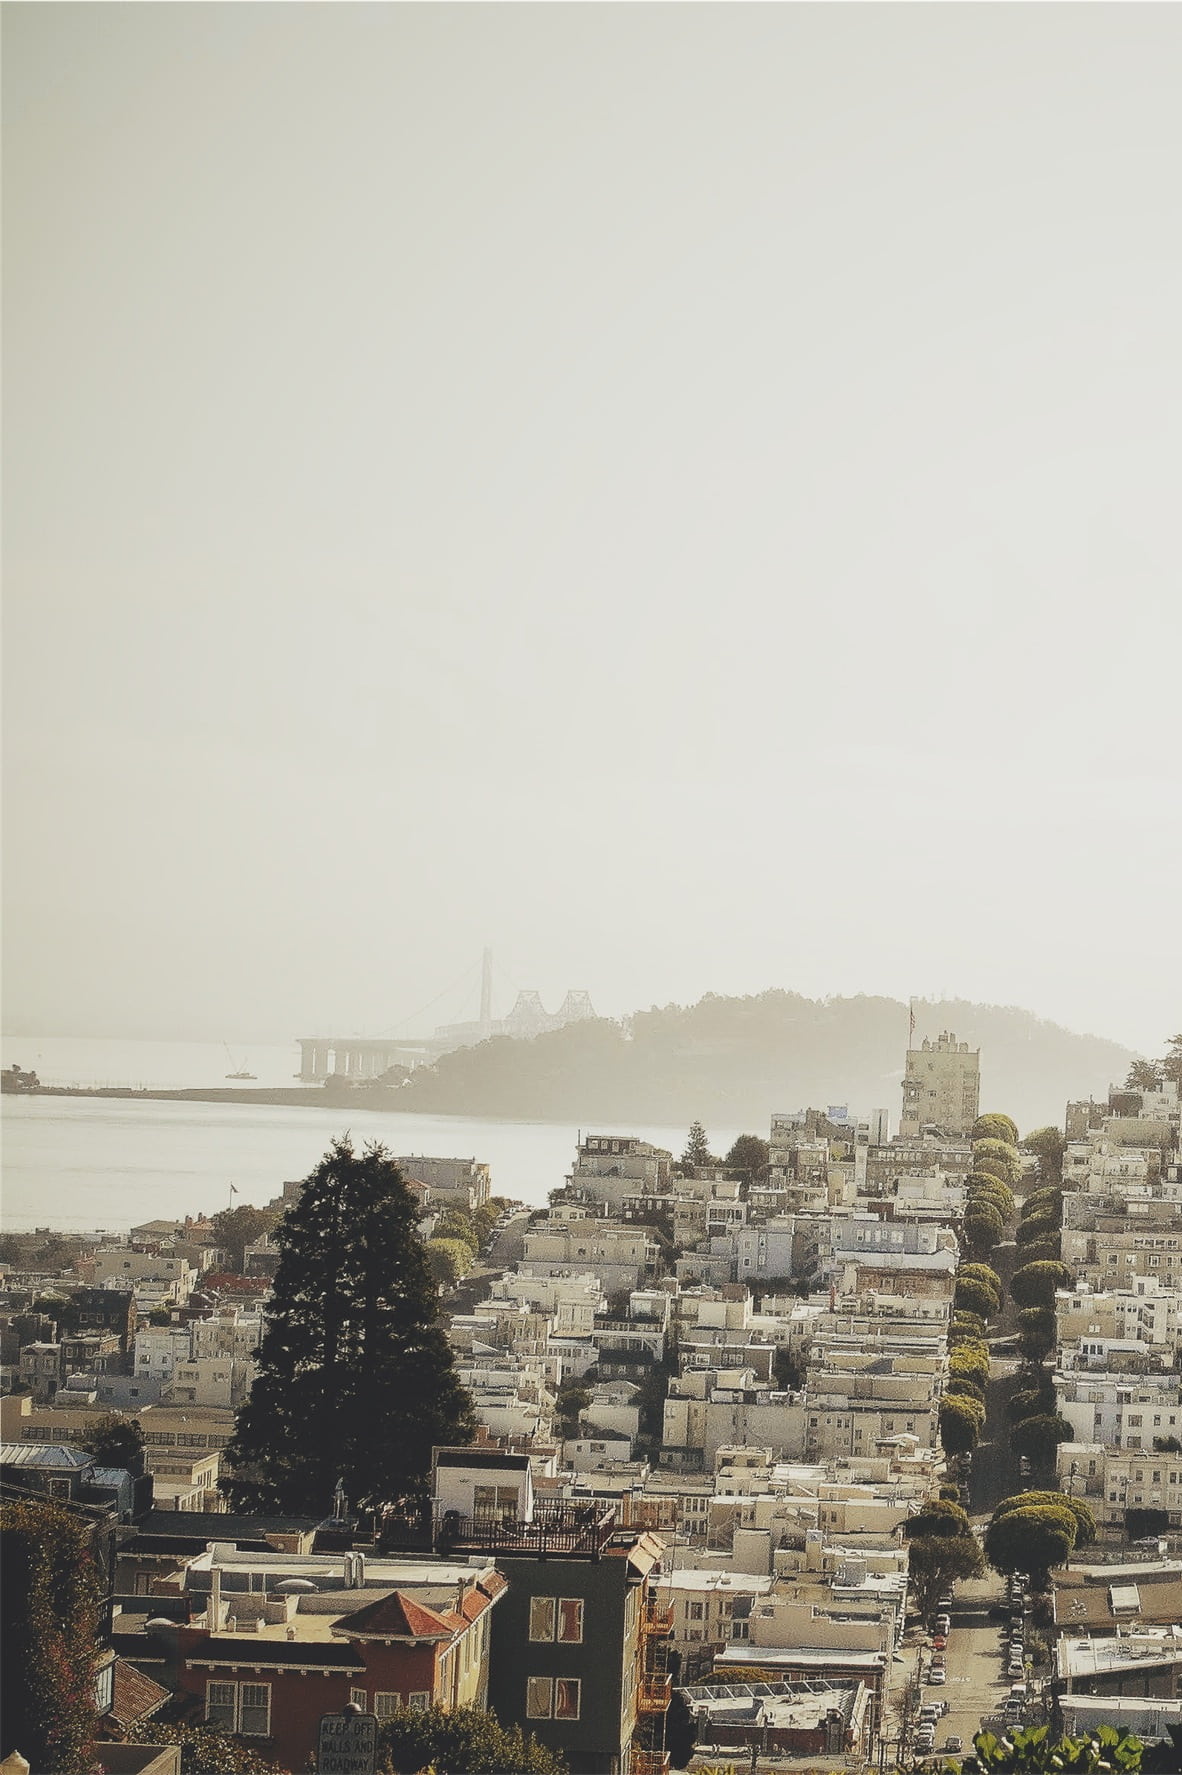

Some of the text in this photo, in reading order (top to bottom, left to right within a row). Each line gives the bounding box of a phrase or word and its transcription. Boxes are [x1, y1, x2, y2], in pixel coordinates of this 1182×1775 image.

[322, 1722, 373, 1735] KEEP OFF
[321, 1740, 373, 1753] WALLS AND
[322, 1758, 368, 1771] ROADWAY
